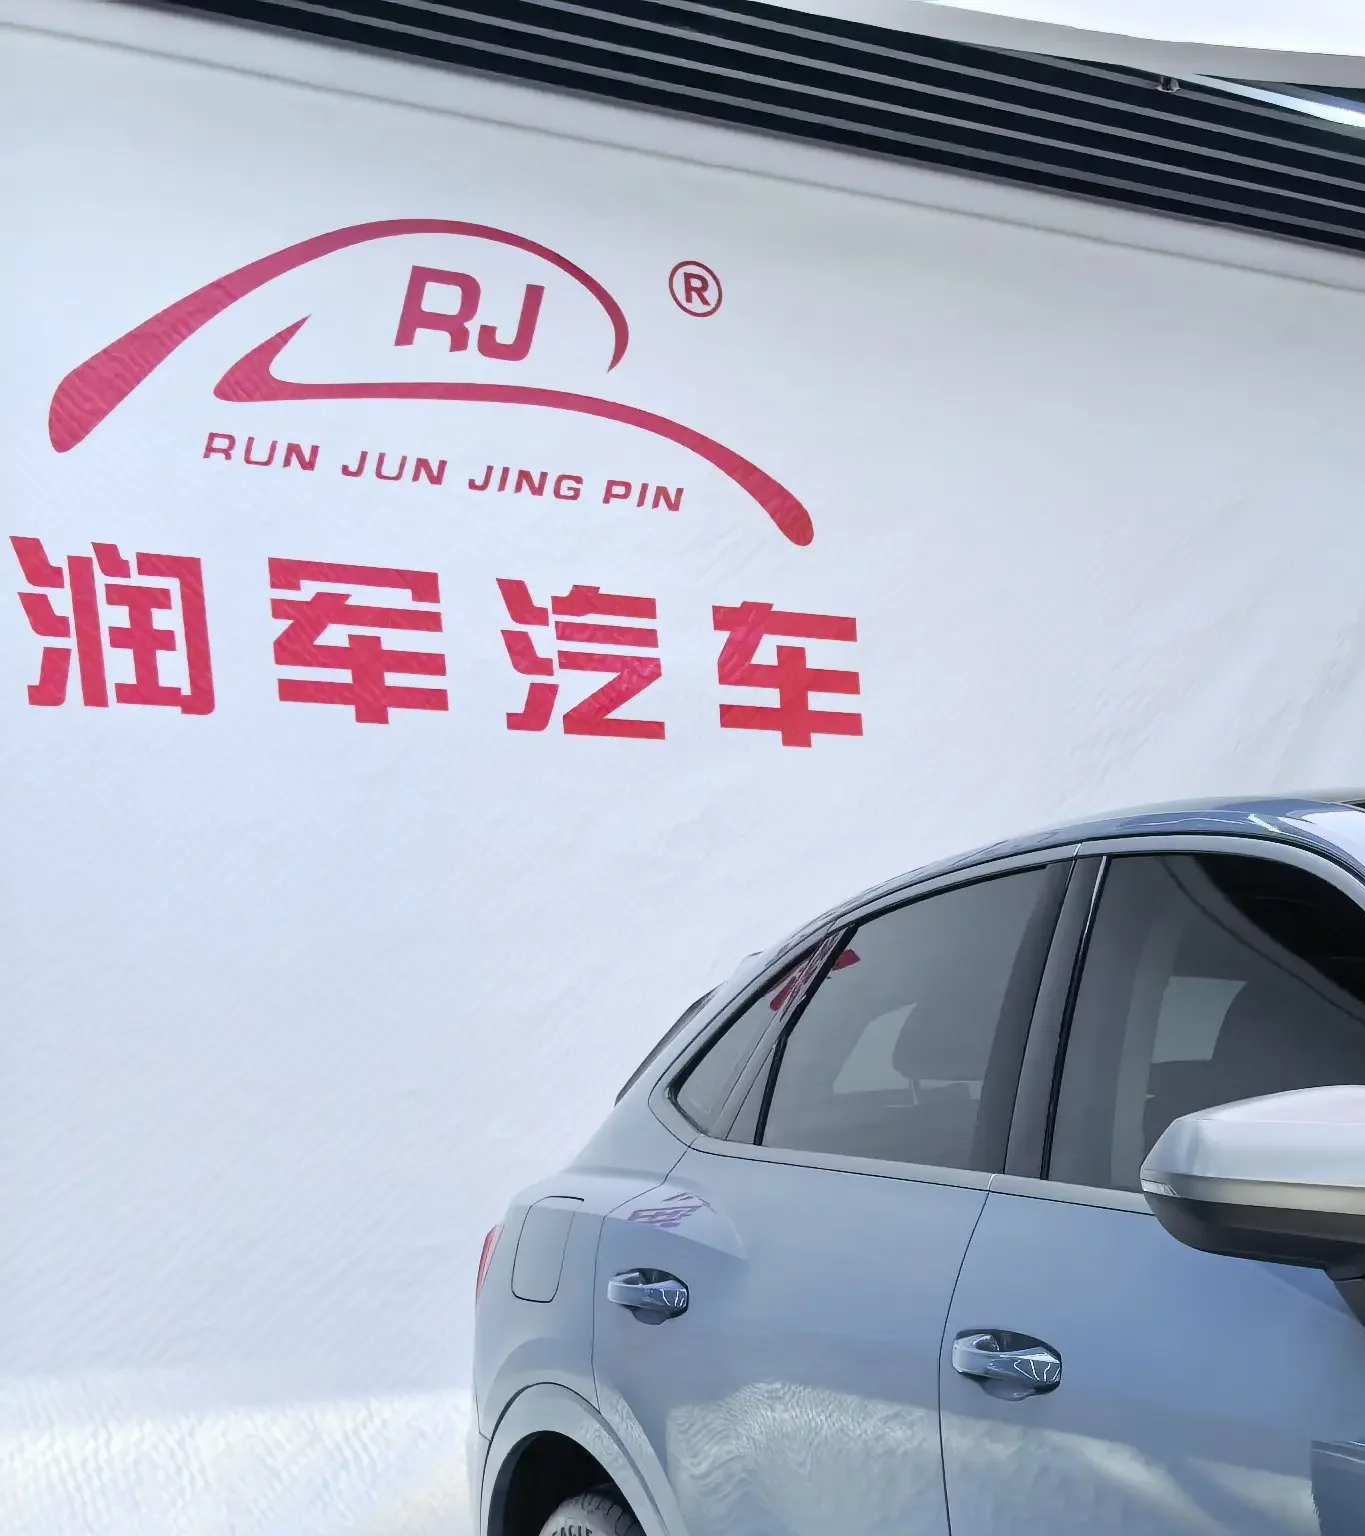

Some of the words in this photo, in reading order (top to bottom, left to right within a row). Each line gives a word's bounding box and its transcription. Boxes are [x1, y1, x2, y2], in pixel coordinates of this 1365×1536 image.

[394, 264, 546, 362] RJ
[202, 431, 321, 472] RUN
[340, 450, 449, 486] JUN
[467, 464, 584, 502] JING
[602, 479, 685, 513] PIN
[9, 534, 865, 749] 润军汽车
